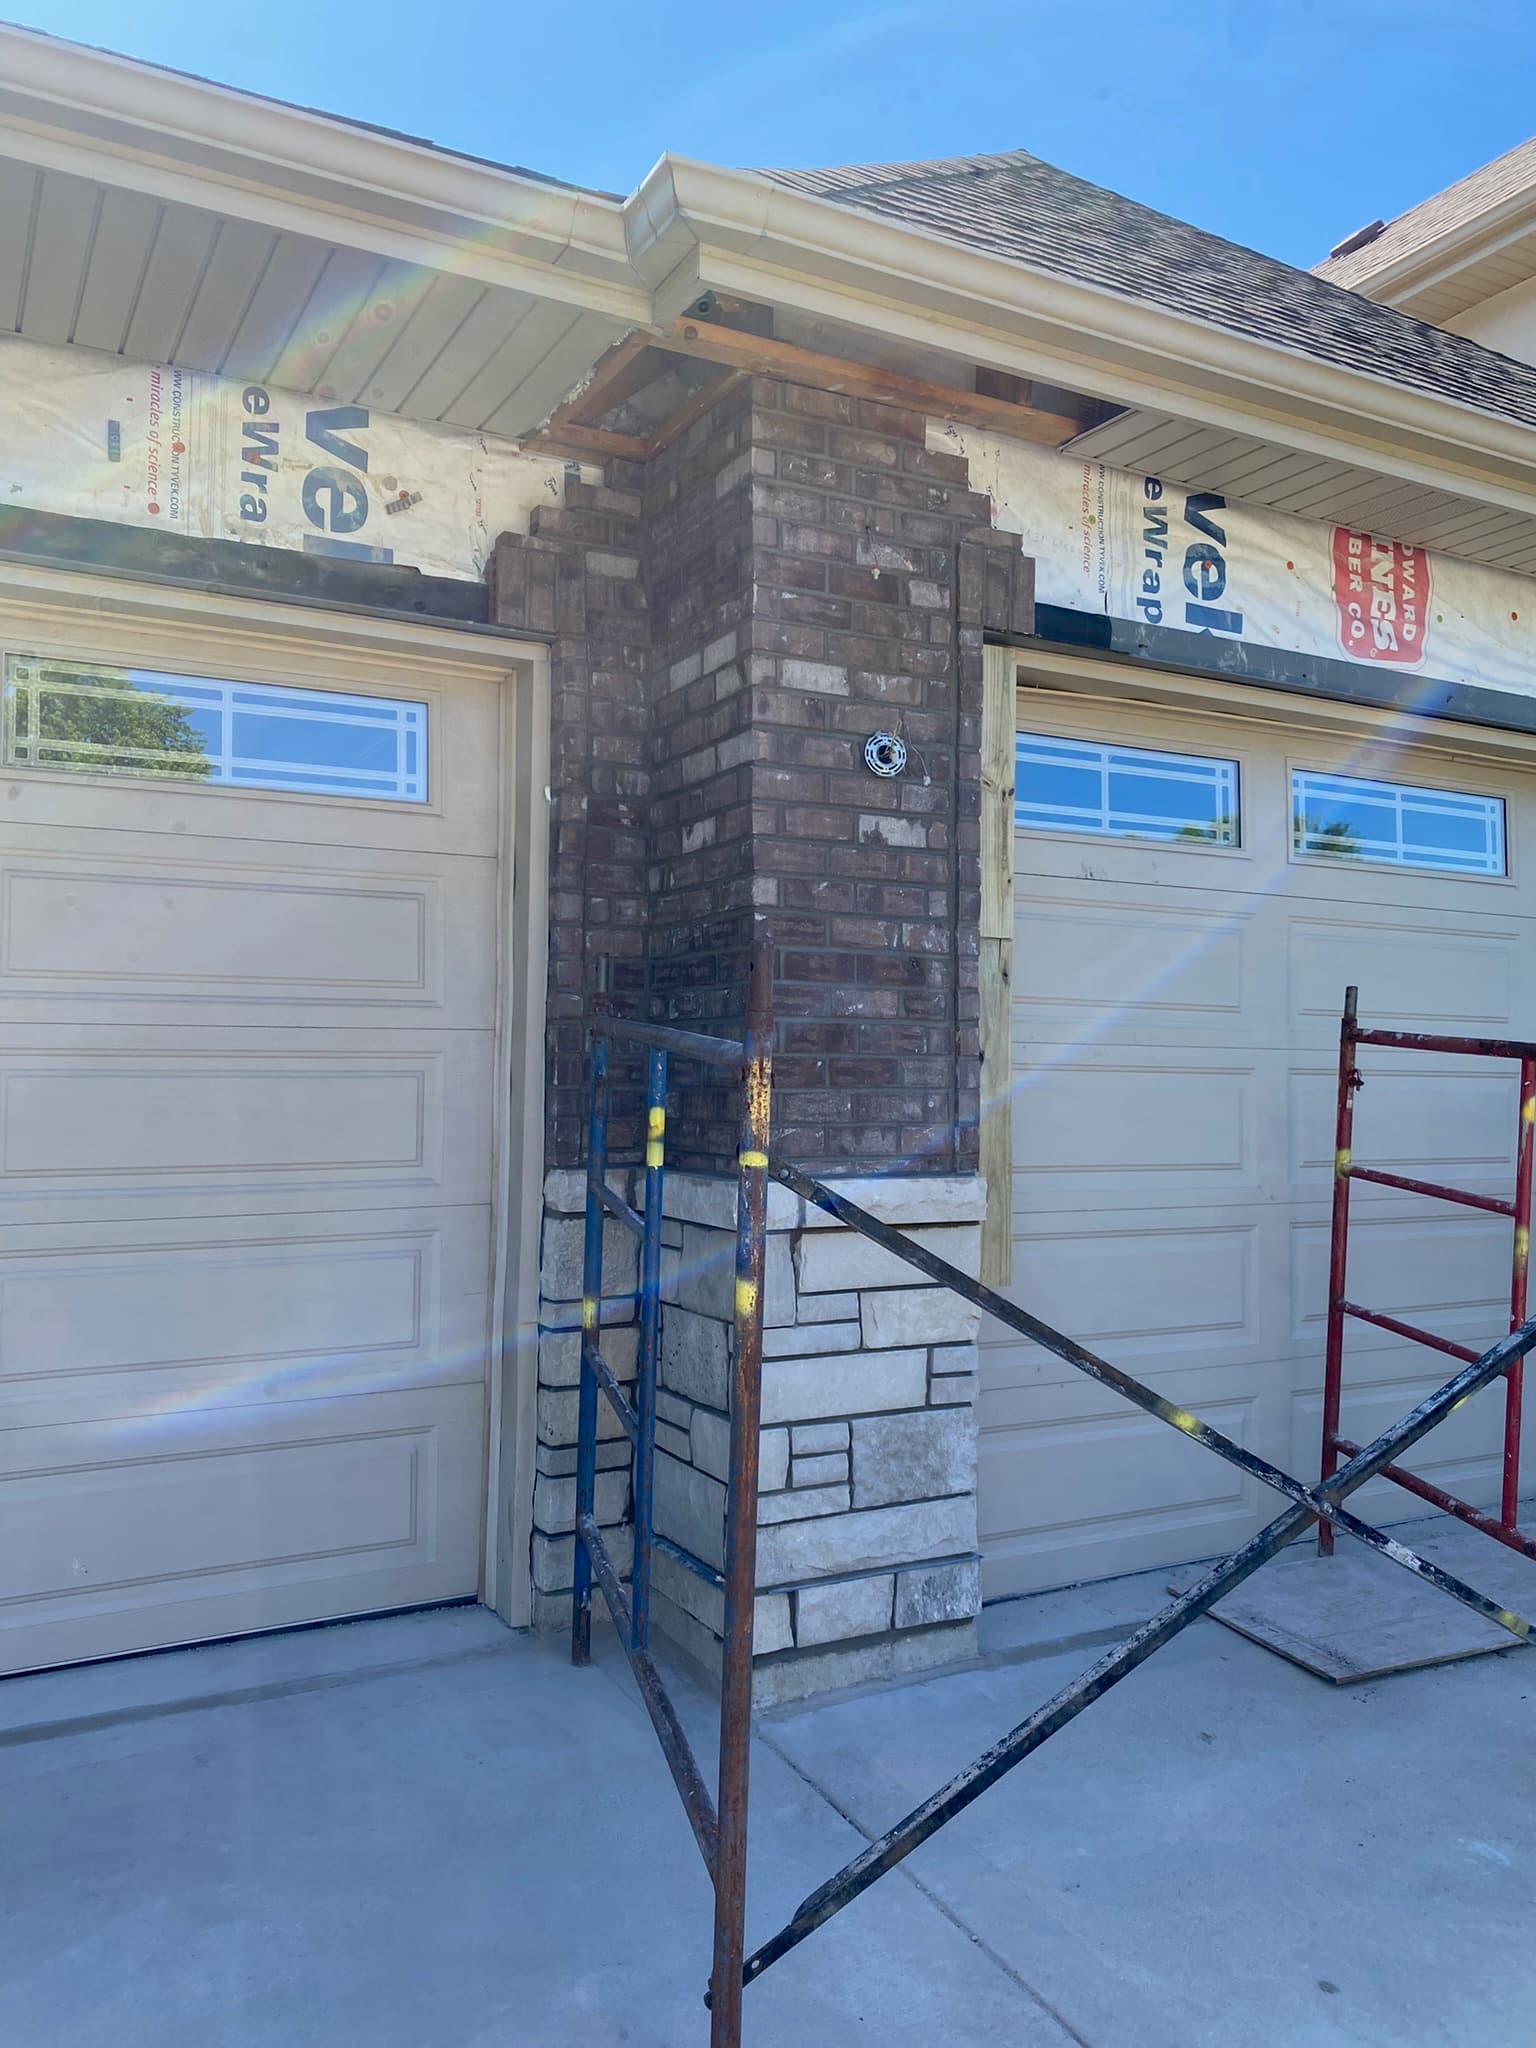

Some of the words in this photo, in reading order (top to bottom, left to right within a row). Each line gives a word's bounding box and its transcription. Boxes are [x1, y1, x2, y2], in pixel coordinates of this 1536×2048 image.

[149, 370, 164, 426] miracles
[146, 430, 161, 447] of
[148, 447, 162, 496] science
[1082, 464, 1093, 513] miracles
[1083, 530, 1094, 573] science
[1136, 477, 1168, 624] eWrap
[1347, 530, 1363, 591] BER
